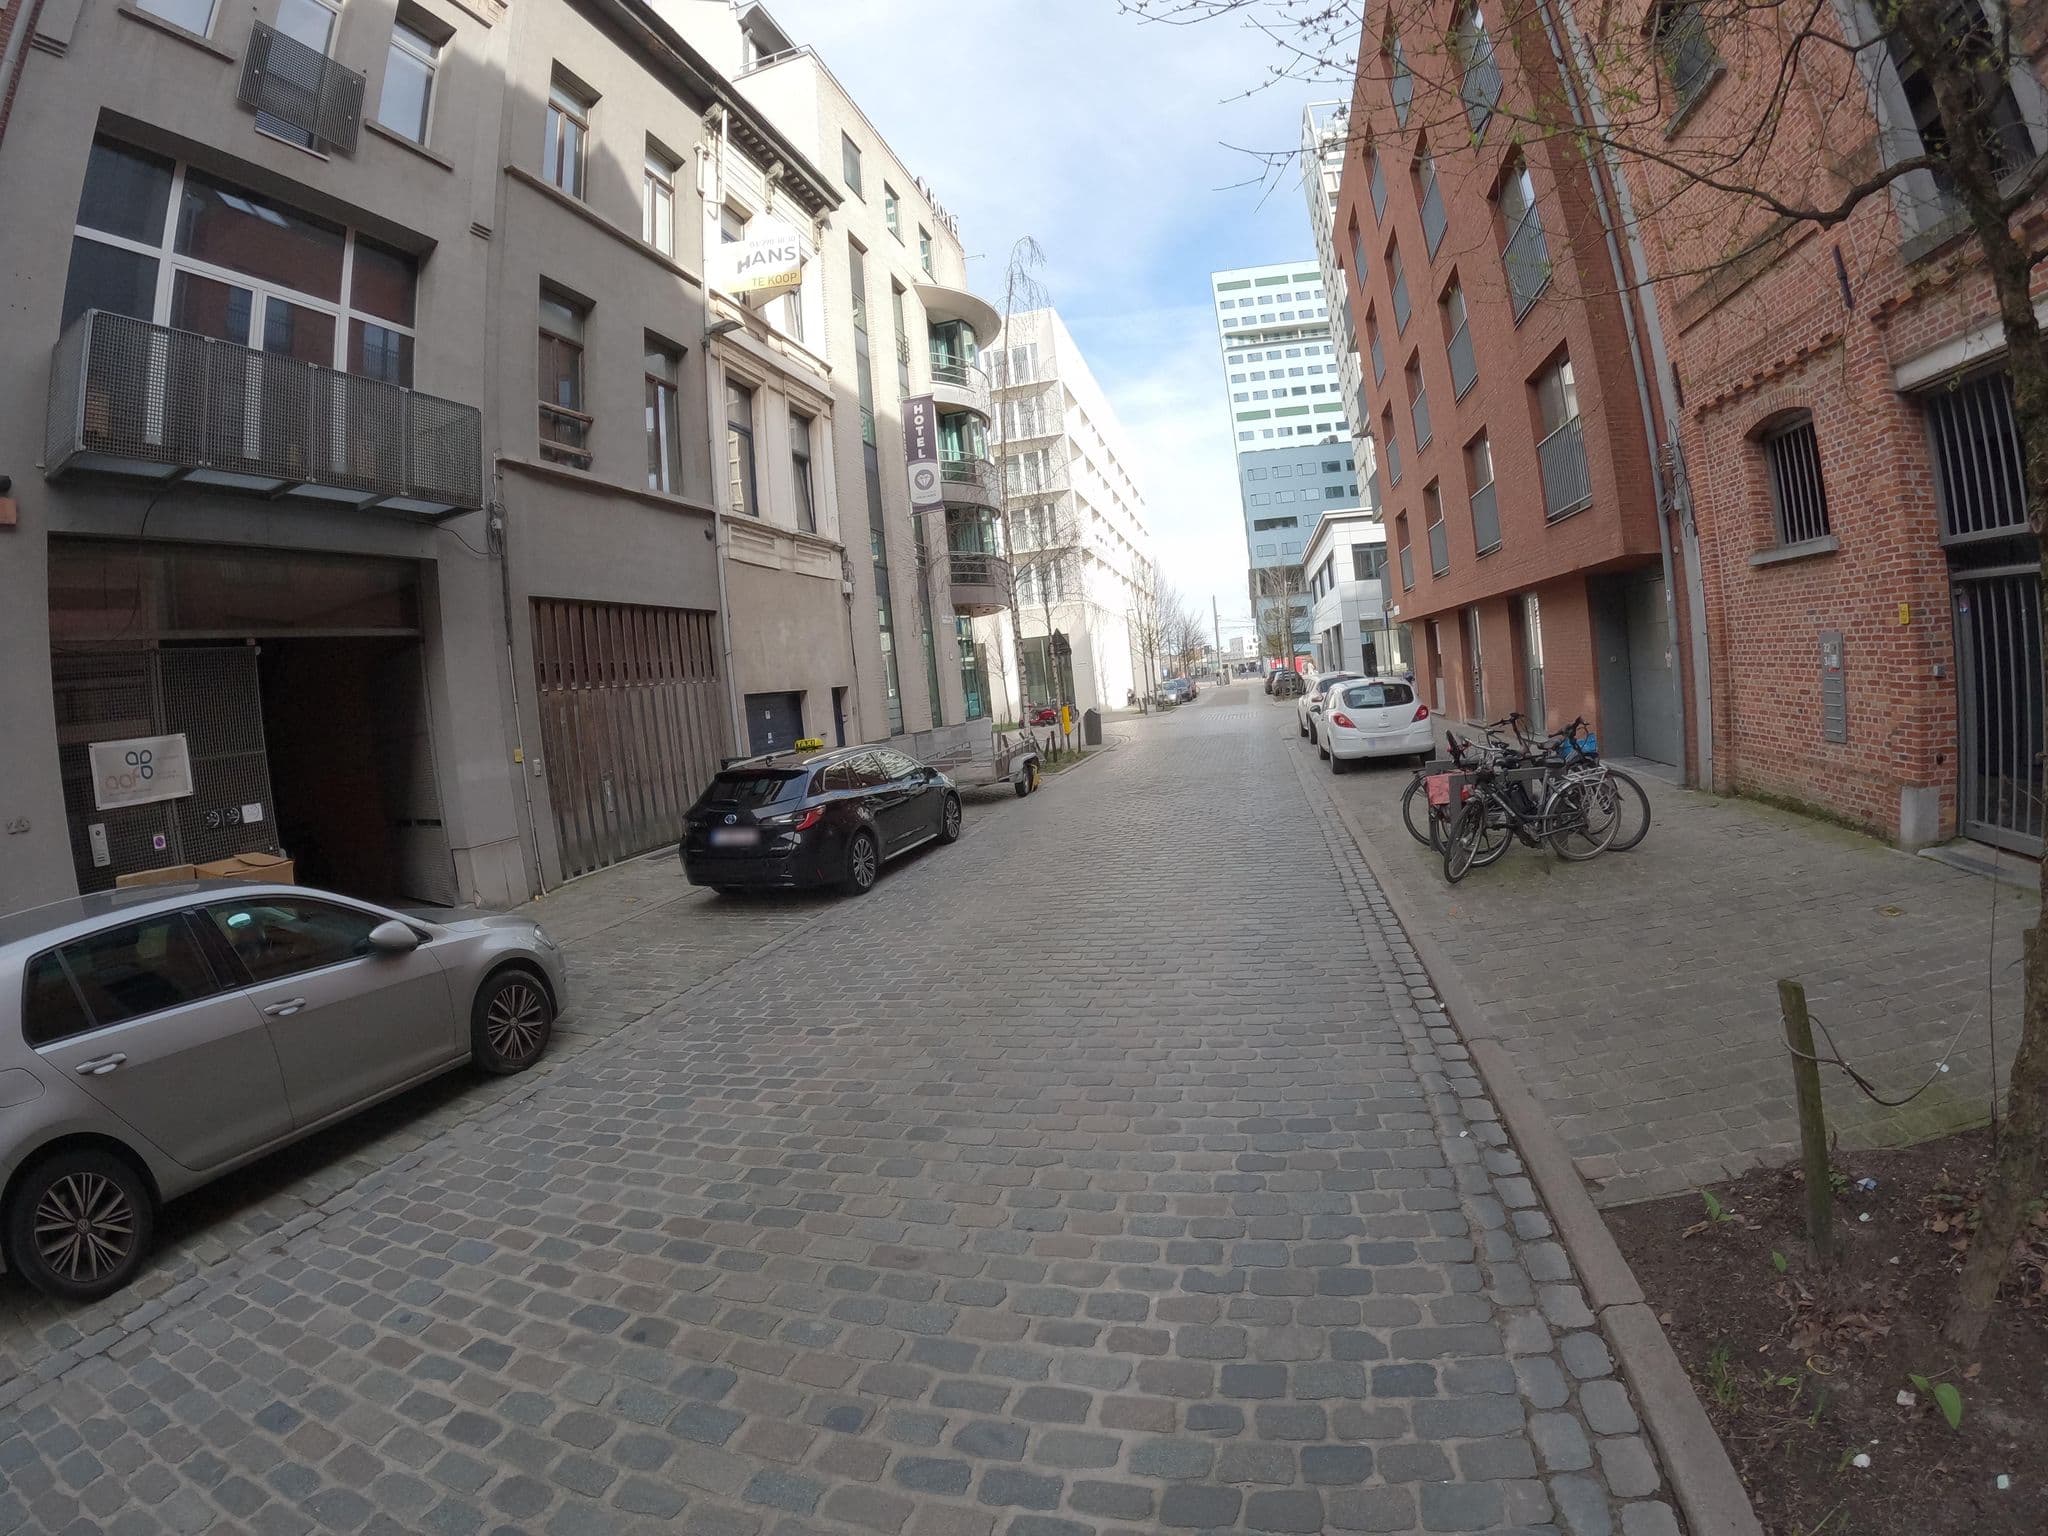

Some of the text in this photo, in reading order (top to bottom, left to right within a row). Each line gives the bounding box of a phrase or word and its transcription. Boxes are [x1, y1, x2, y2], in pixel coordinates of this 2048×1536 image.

[737, 246, 796, 274] HANS
[752, 272, 797, 287] TE KOOP
[913, 403, 926, 459] HOTEL
[797, 740, 815, 749] TAXI
